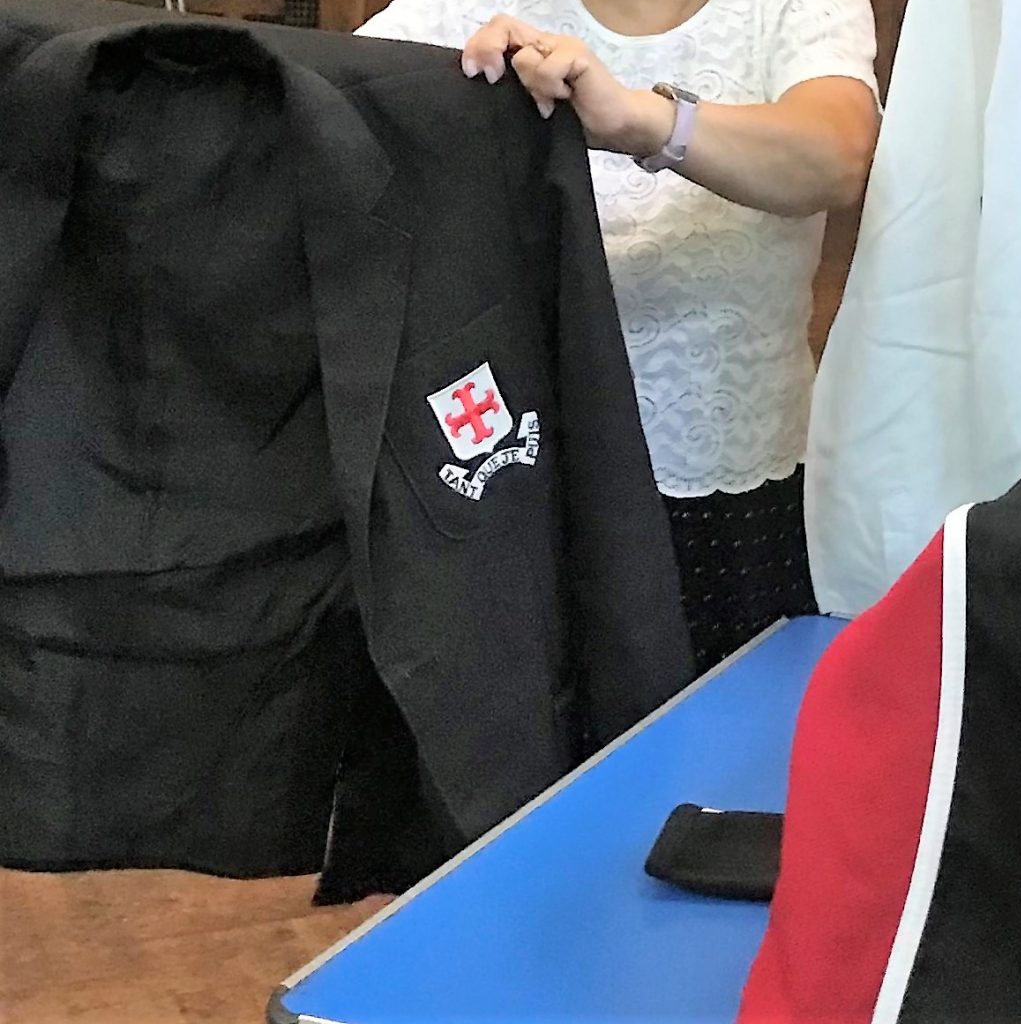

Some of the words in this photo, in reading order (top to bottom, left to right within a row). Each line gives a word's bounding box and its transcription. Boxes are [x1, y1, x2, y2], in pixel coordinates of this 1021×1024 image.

[444, 469, 478, 498] TANT
[477, 456, 500, 482] QUE
[502, 449, 520, 464] JE
[526, 419, 540, 458] PUIS
